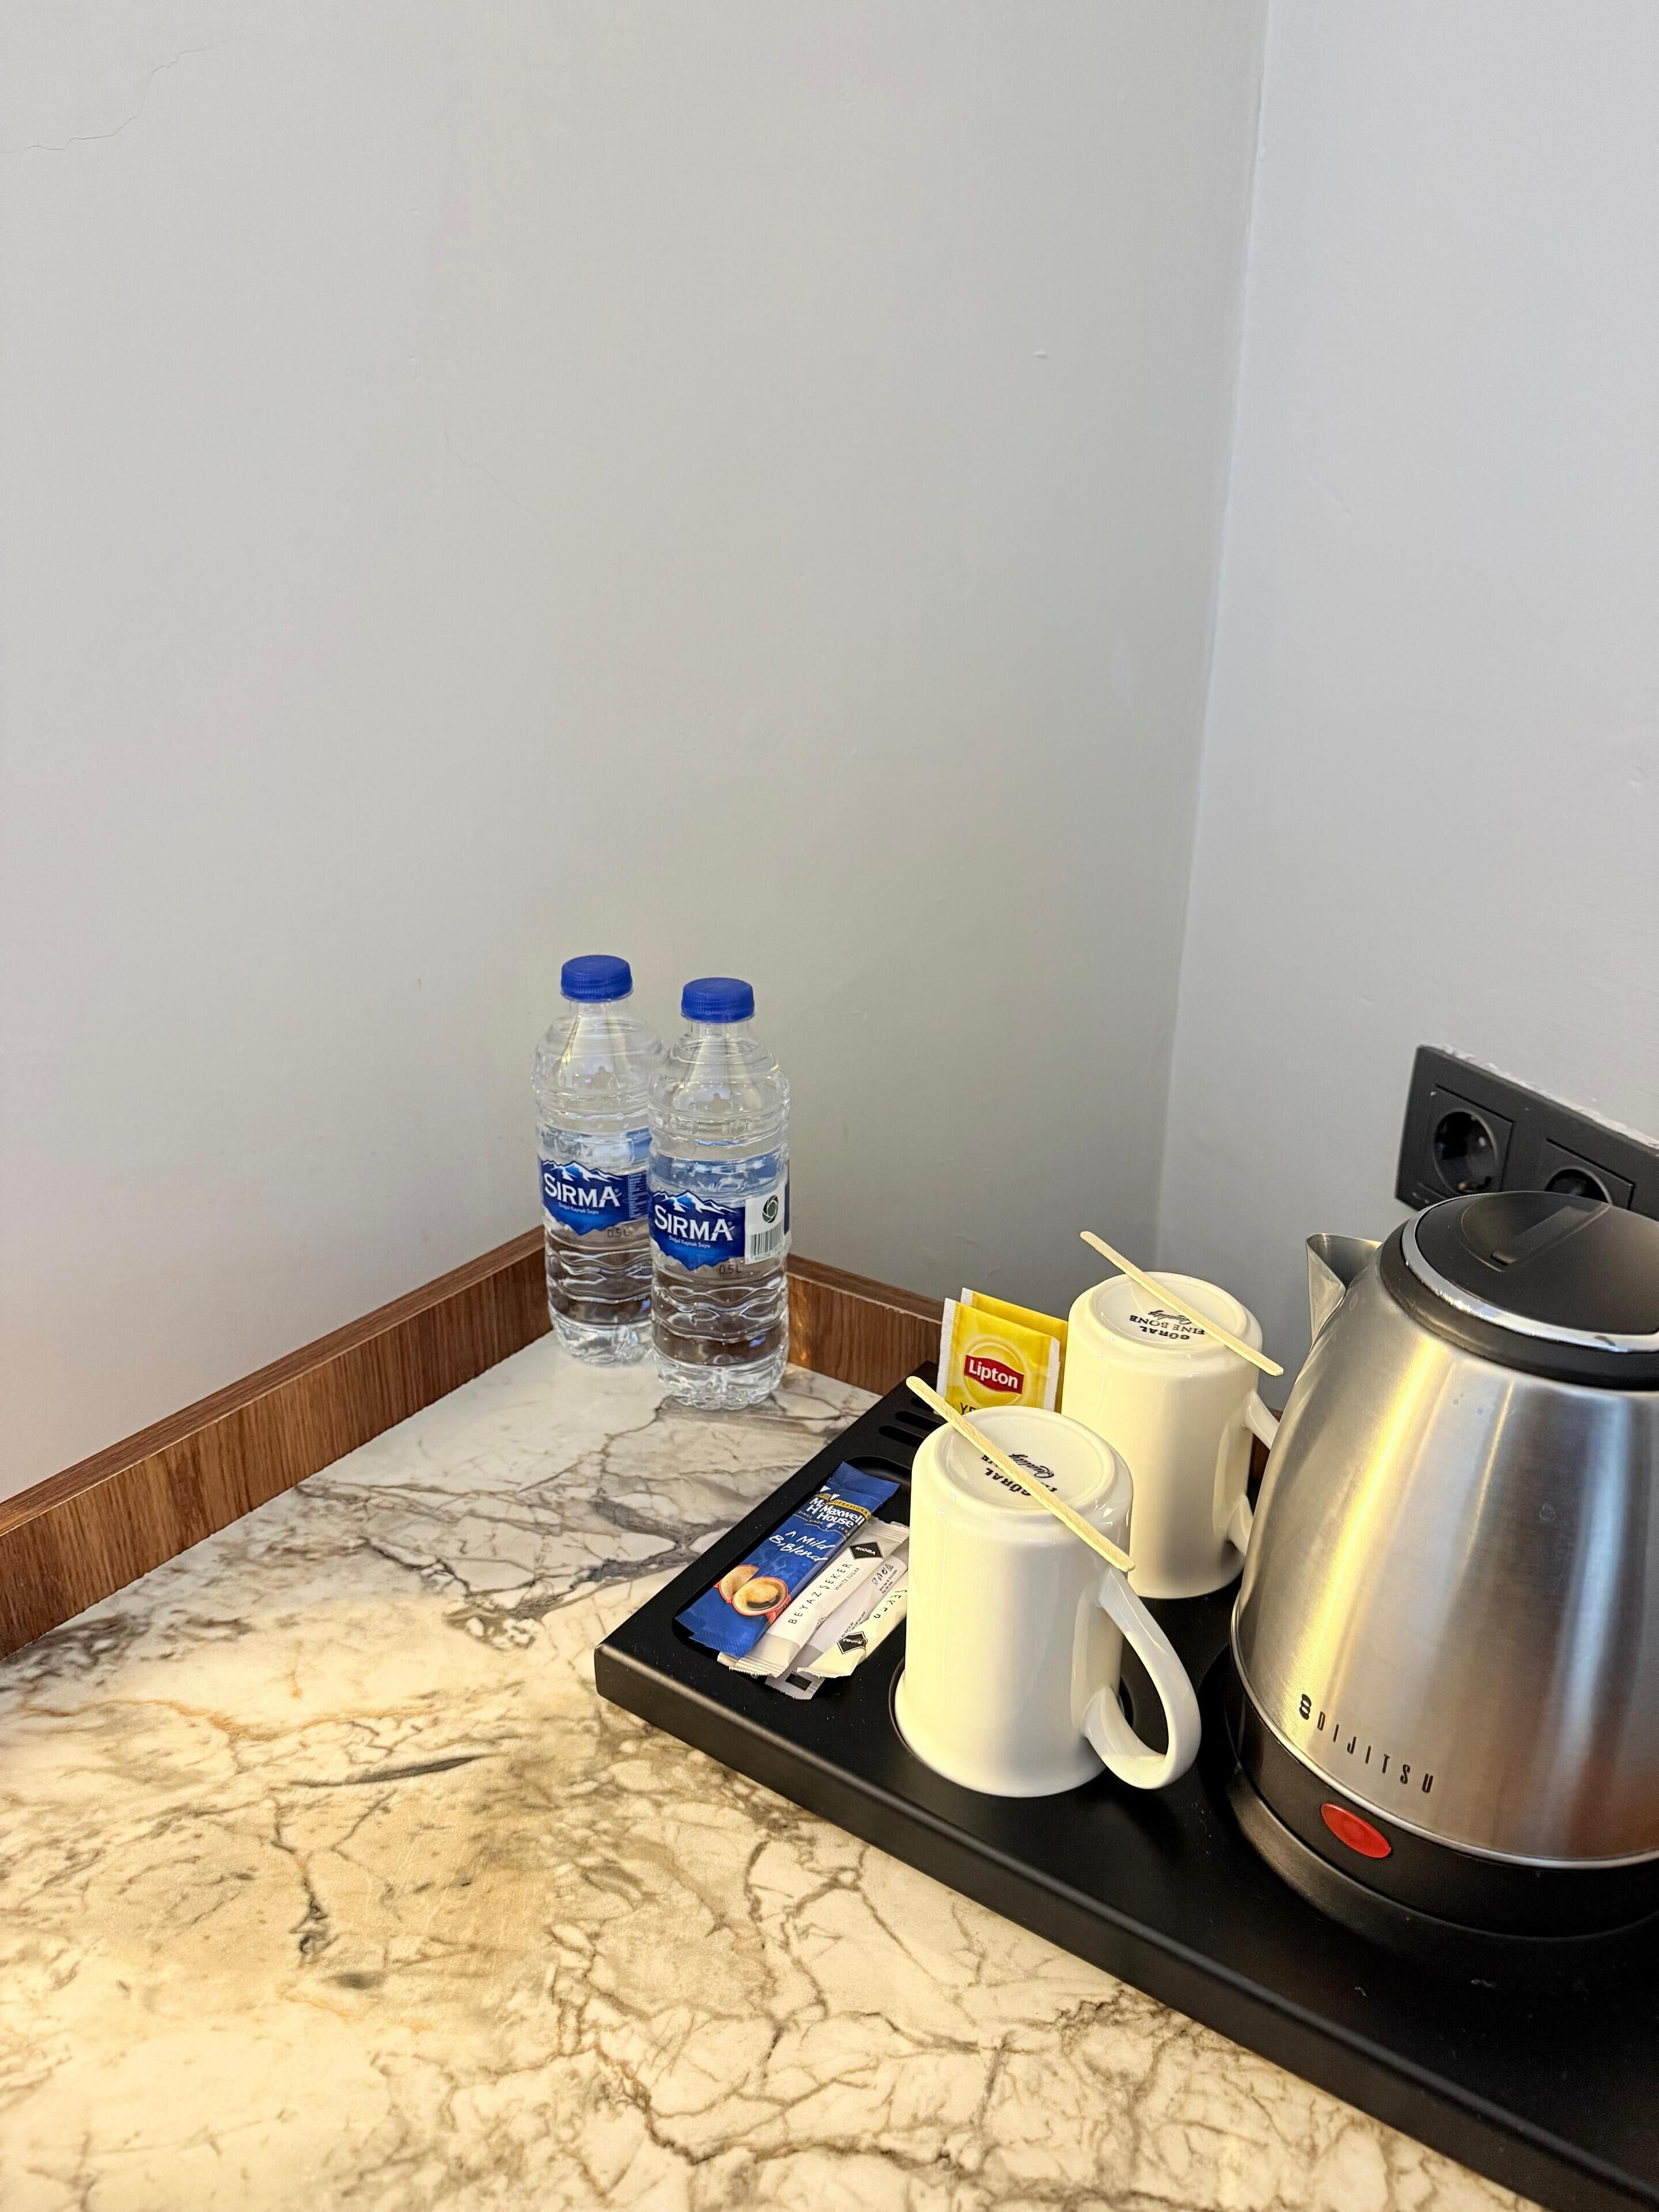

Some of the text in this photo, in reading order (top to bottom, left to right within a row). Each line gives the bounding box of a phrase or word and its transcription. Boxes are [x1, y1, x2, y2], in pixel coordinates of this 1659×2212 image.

[544, 1173, 620, 1207] SIRMA
[654, 1205, 733, 1241] SIRMA
[968, 1359, 1018, 1389] Lipton
[1008, 1454, 1055, 1478] Quality
[816, 1512, 854, 1528] House
[819, 1505, 865, 1527] Maxwell
[780, 1543, 828, 1562] Blend
[796, 1536, 835, 1550] Mild
[855, 1546, 876, 1555] RIOBA
[788, 1592, 821, 1624] BEYAZ
[820, 1563, 853, 1590] ŞEKER
[1317, 1711, 1434, 1793] DIJITSU
